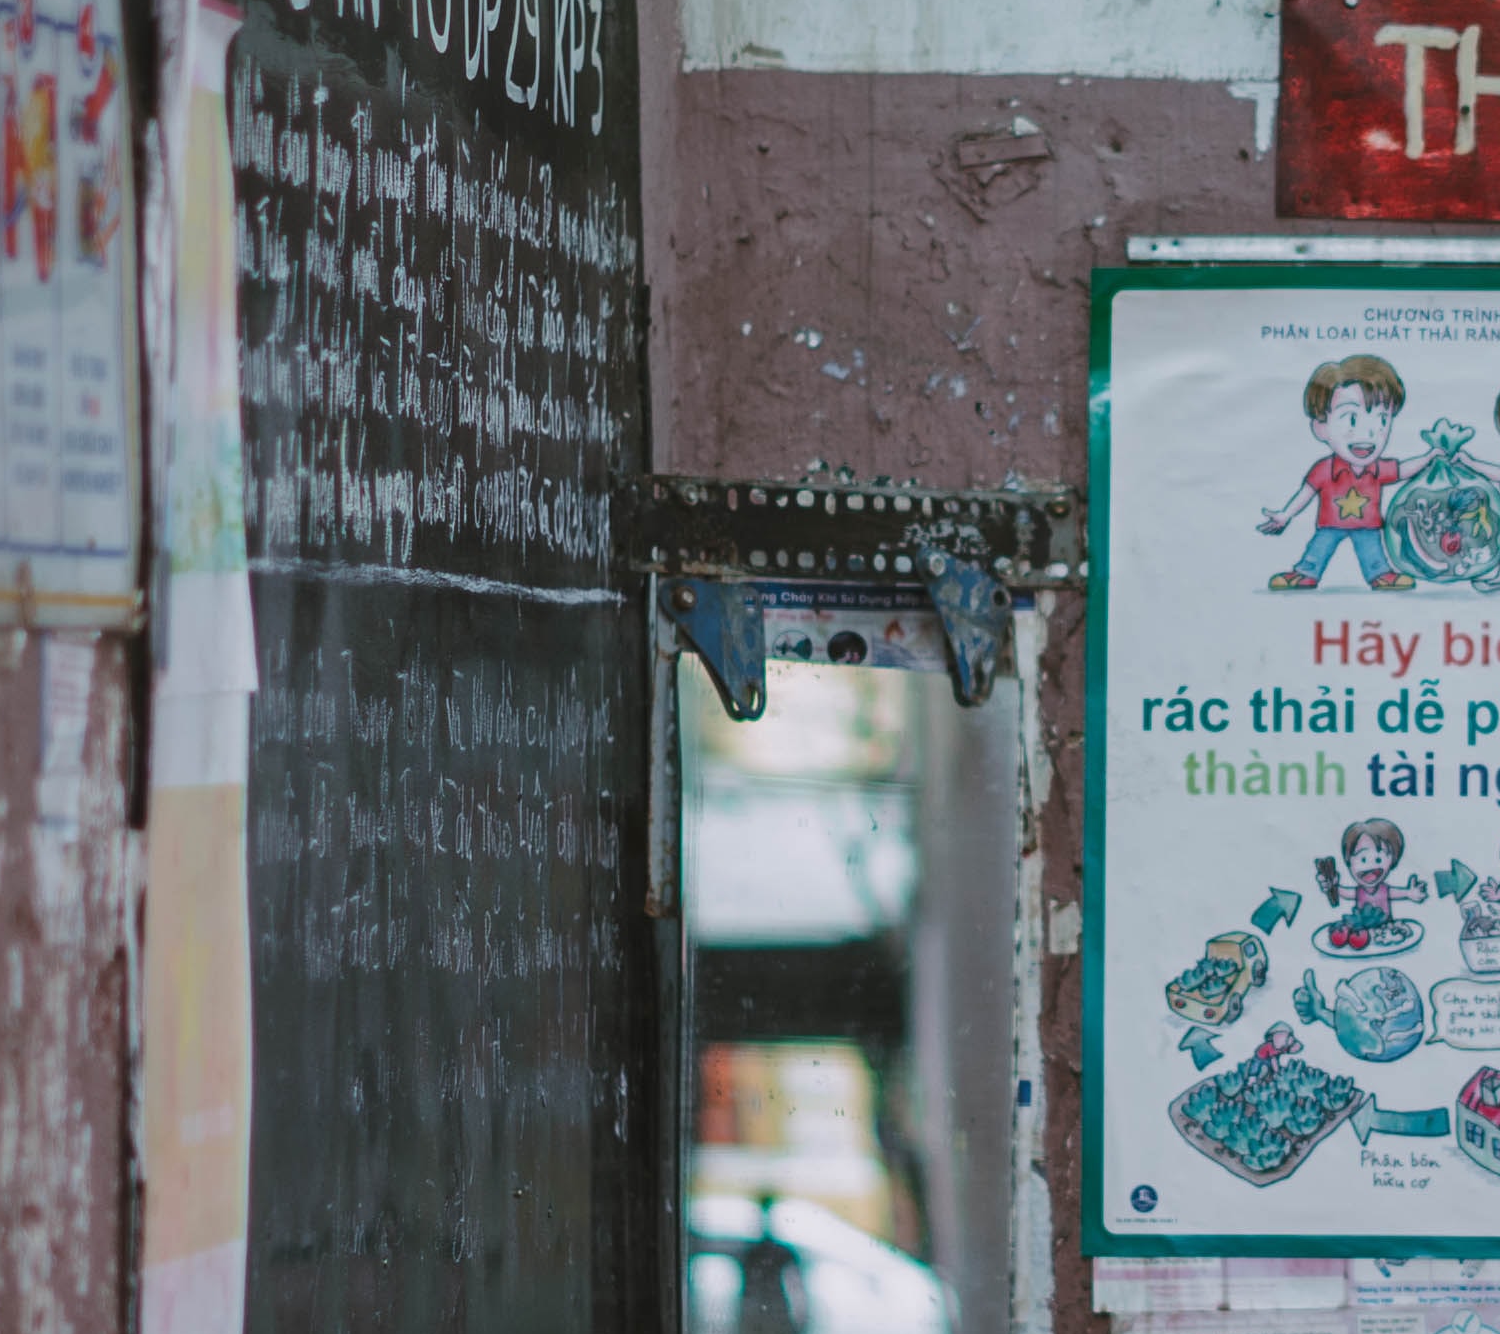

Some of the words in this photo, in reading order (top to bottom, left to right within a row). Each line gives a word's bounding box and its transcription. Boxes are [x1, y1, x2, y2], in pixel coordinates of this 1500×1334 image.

[1261, 324, 1309, 340] PHÂN
[1316, 326, 1358, 341] LOẠI
[1312, 620, 1420, 678] Hãy
[1141, 687, 1230, 733] rác
[1249, 686, 1355, 735] thải
[1377, 678, 1445, 736] dễ
[1182, 749, 1346, 797] thành
[1367, 752, 1435, 798] tài
[1360, 1149, 1404, 1170] Phân
